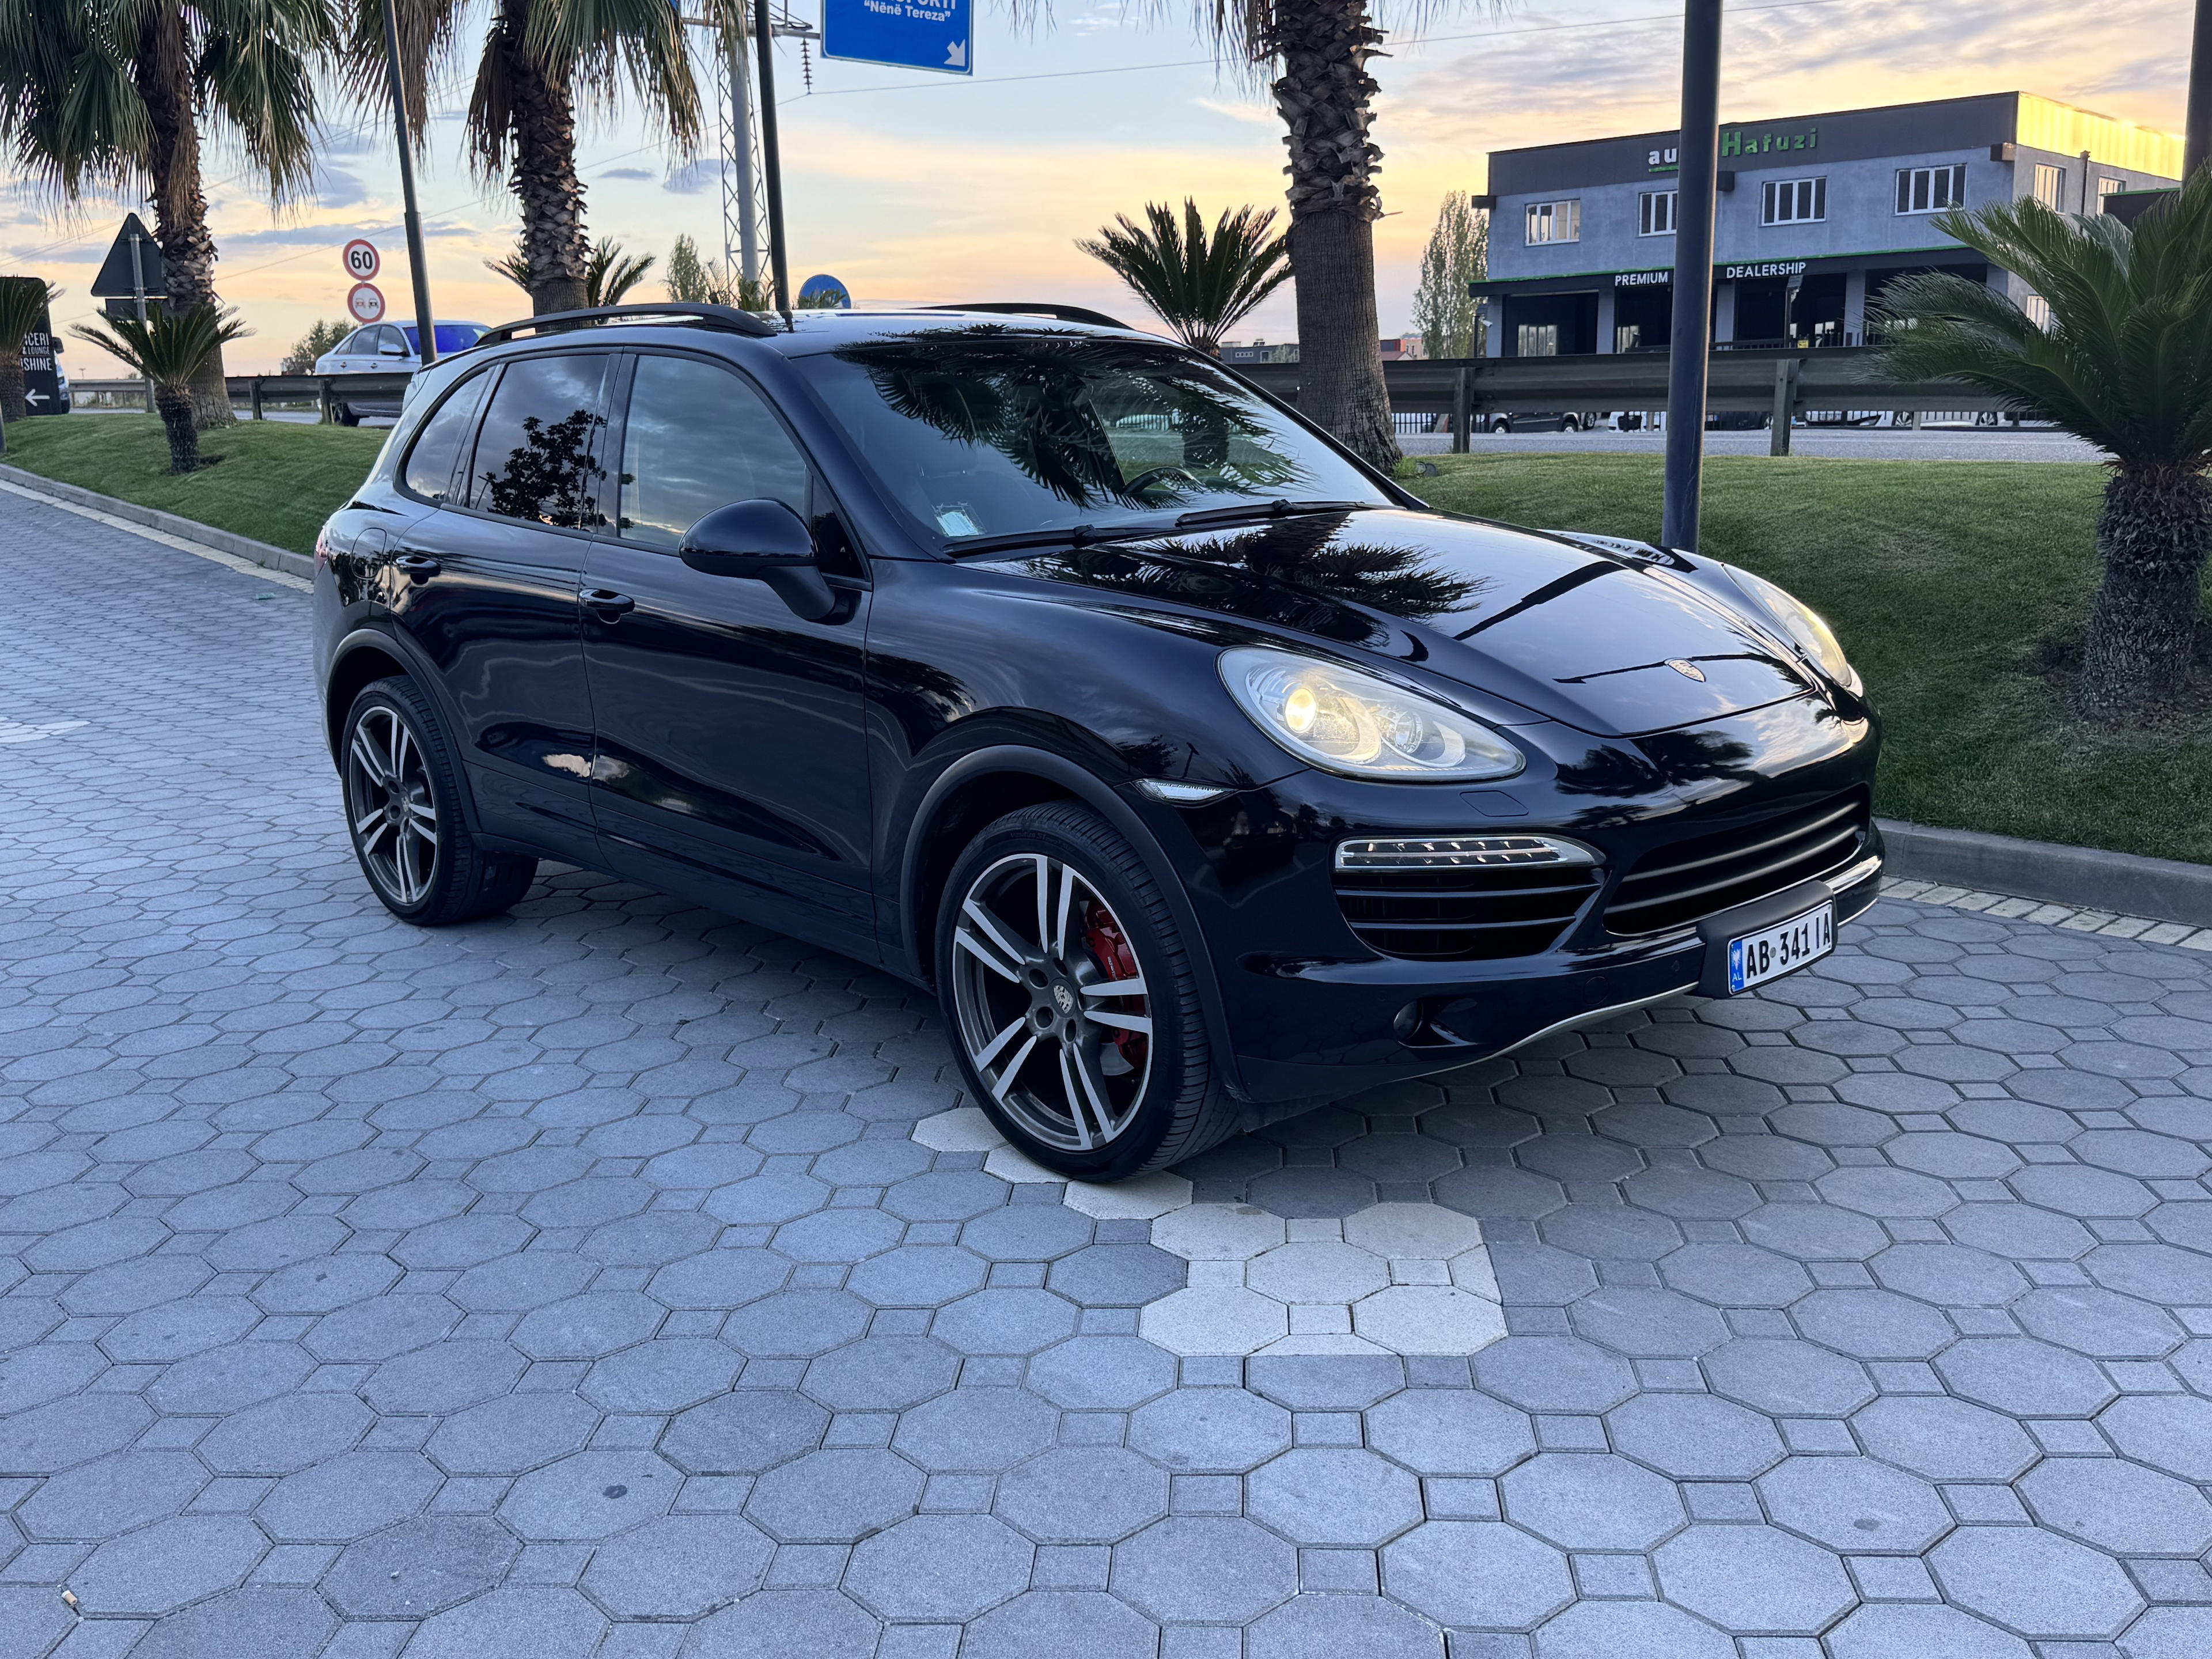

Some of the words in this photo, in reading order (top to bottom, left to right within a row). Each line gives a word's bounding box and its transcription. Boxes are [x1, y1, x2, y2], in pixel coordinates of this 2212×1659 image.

[1648, 148, 1677, 165] au
[1721, 127, 1816, 157] Hafuzi
[350, 251, 373, 270] 60
[1615, 271, 1668, 286] PREMIUM
[1726, 262, 1806, 279] DEALERSHIP
[1747, 940, 1770, 979] AB
[1779, 922, 1810, 965] 341
[1816, 912, 1831, 949] IA
[1732, 972, 1742, 982] AL
